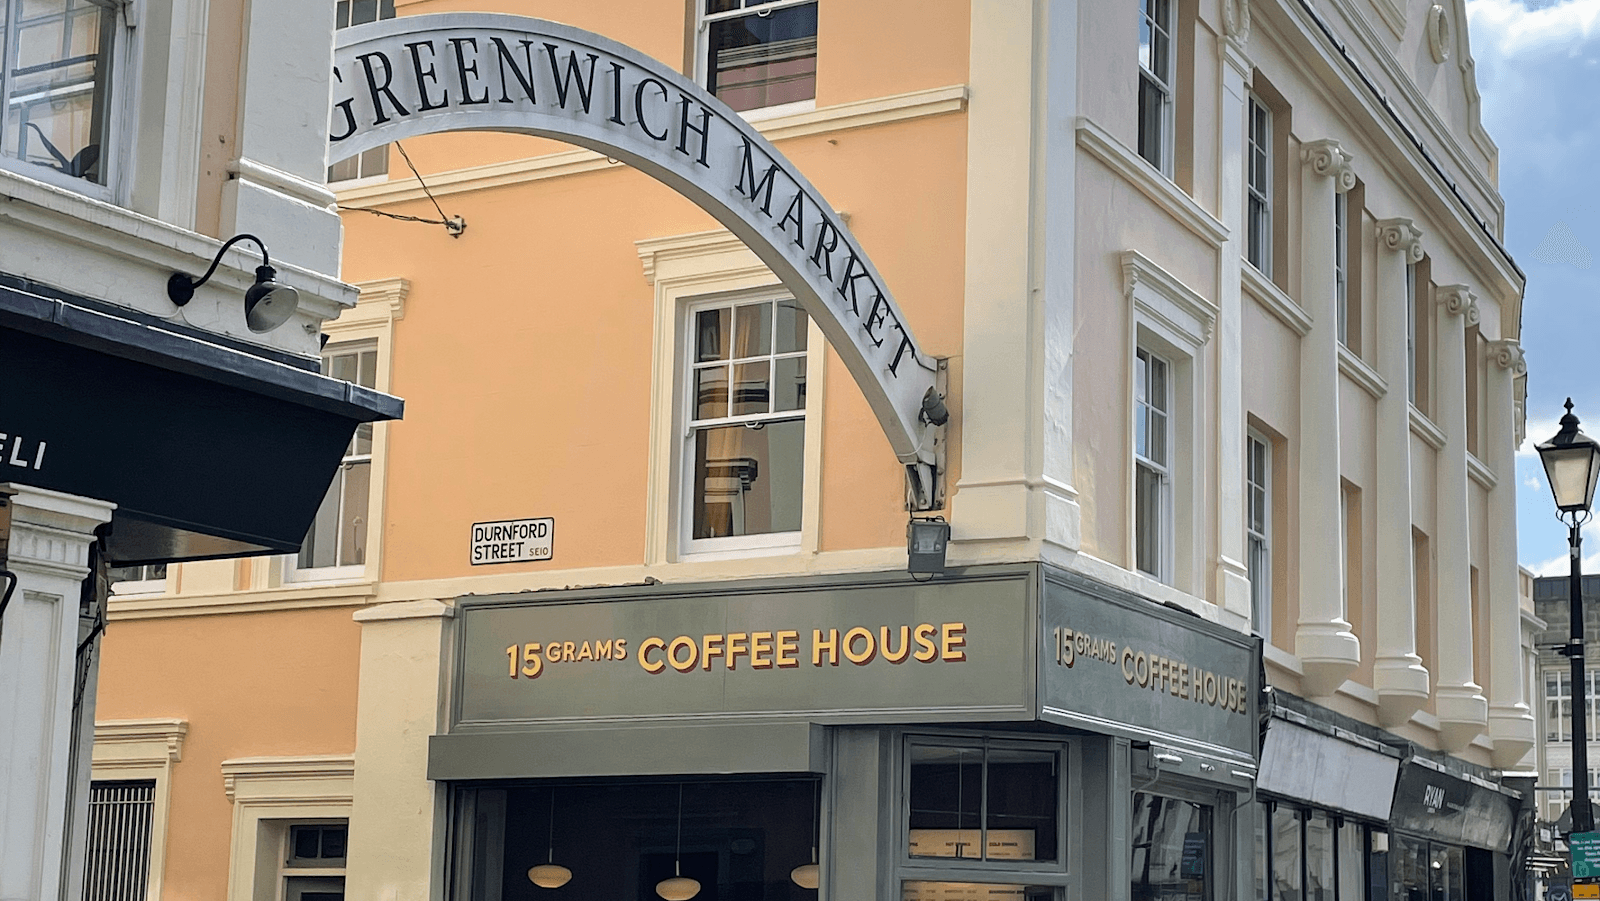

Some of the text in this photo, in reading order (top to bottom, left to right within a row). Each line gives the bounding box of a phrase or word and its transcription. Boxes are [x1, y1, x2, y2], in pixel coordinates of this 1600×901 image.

[735, 136, 916, 379] MARKET
[0, 433, 47, 470] LI
[474, 542, 549, 560] STREET SE10
[475, 523, 547, 542] DURNFORD
[637, 630, 799, 674] COFFEE
[812, 622, 967, 667] HOUSE
[1121, 646, 1189, 699] COFFEE
[1193, 667, 1246, 714] HOUSE
